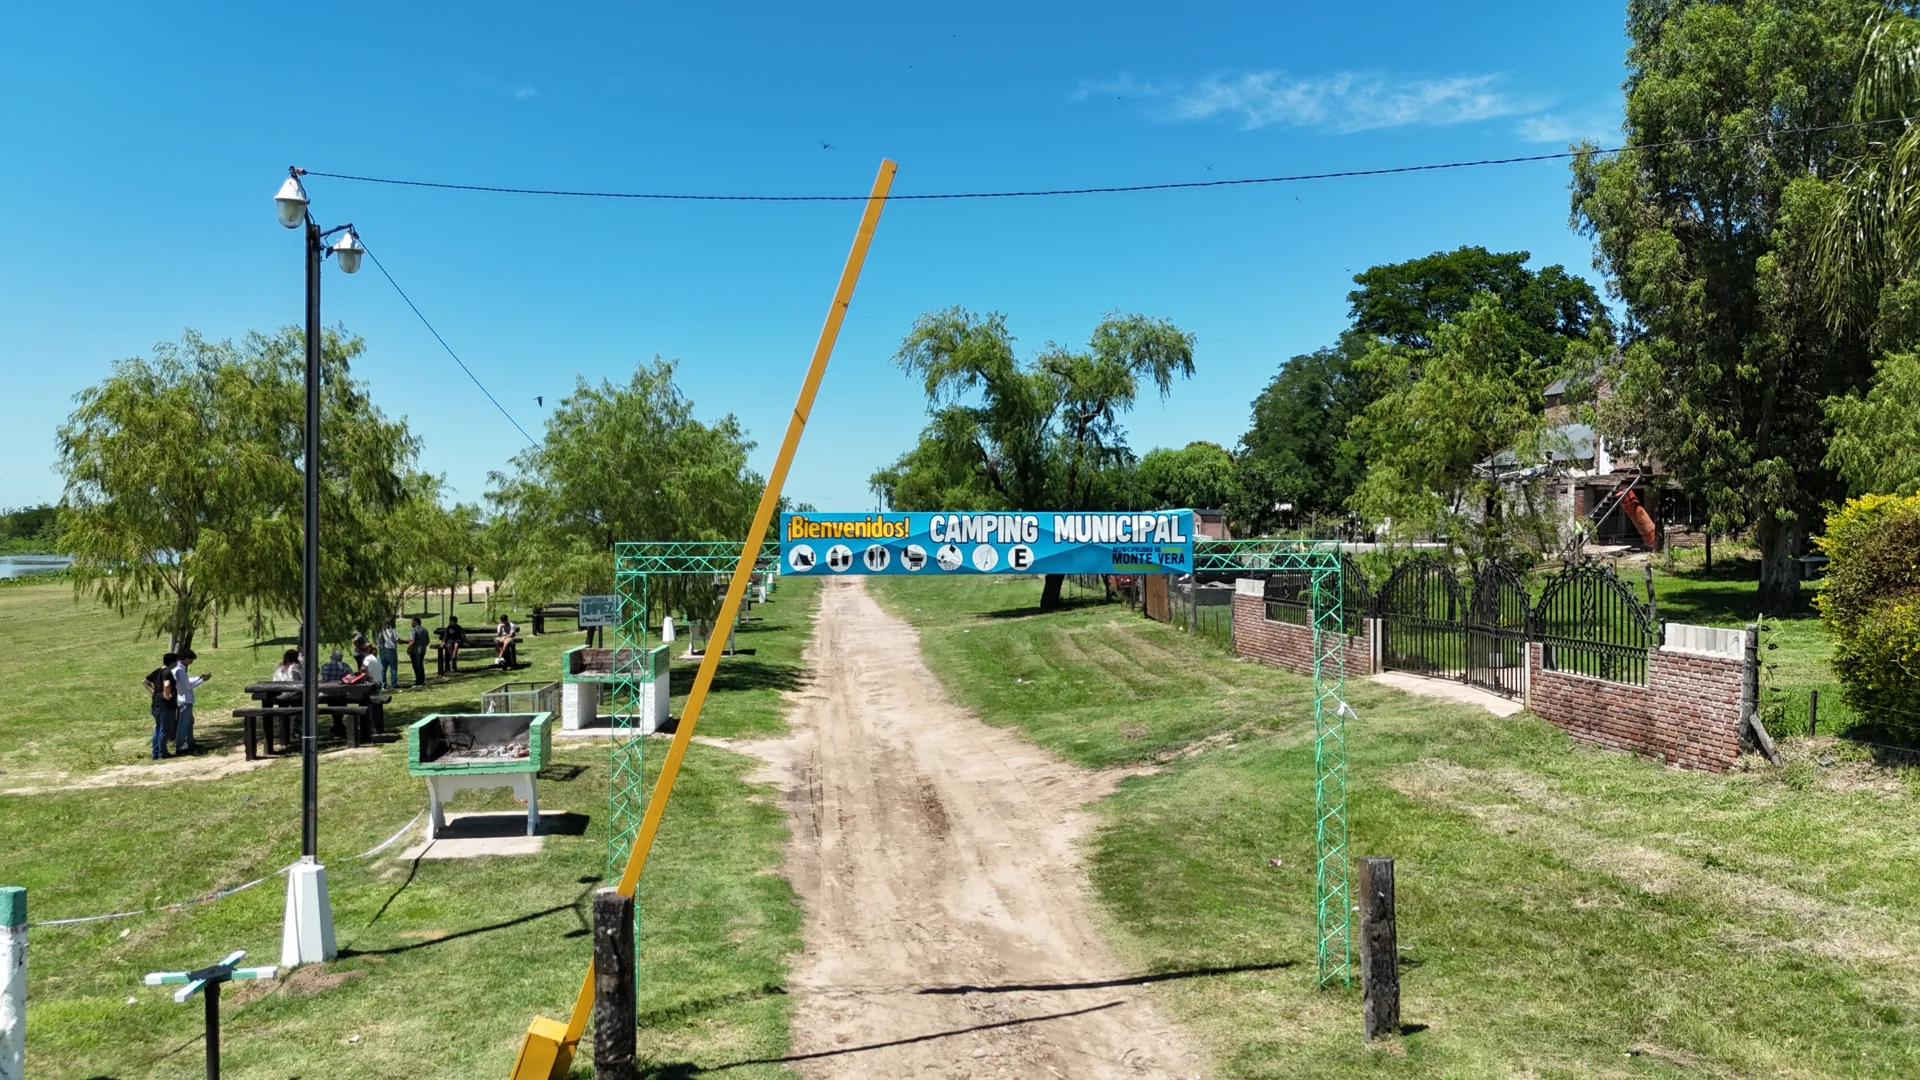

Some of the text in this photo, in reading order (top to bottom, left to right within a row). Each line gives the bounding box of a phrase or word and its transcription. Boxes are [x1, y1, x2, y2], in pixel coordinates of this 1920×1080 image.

[787, 514, 910, 542] ¡Bienvenidos!
[929, 514, 1187, 544] CAMPING MUNICIPAL
[1014, 548, 1028, 568] E
[1112, 553, 1185, 564] MONTE VERA
